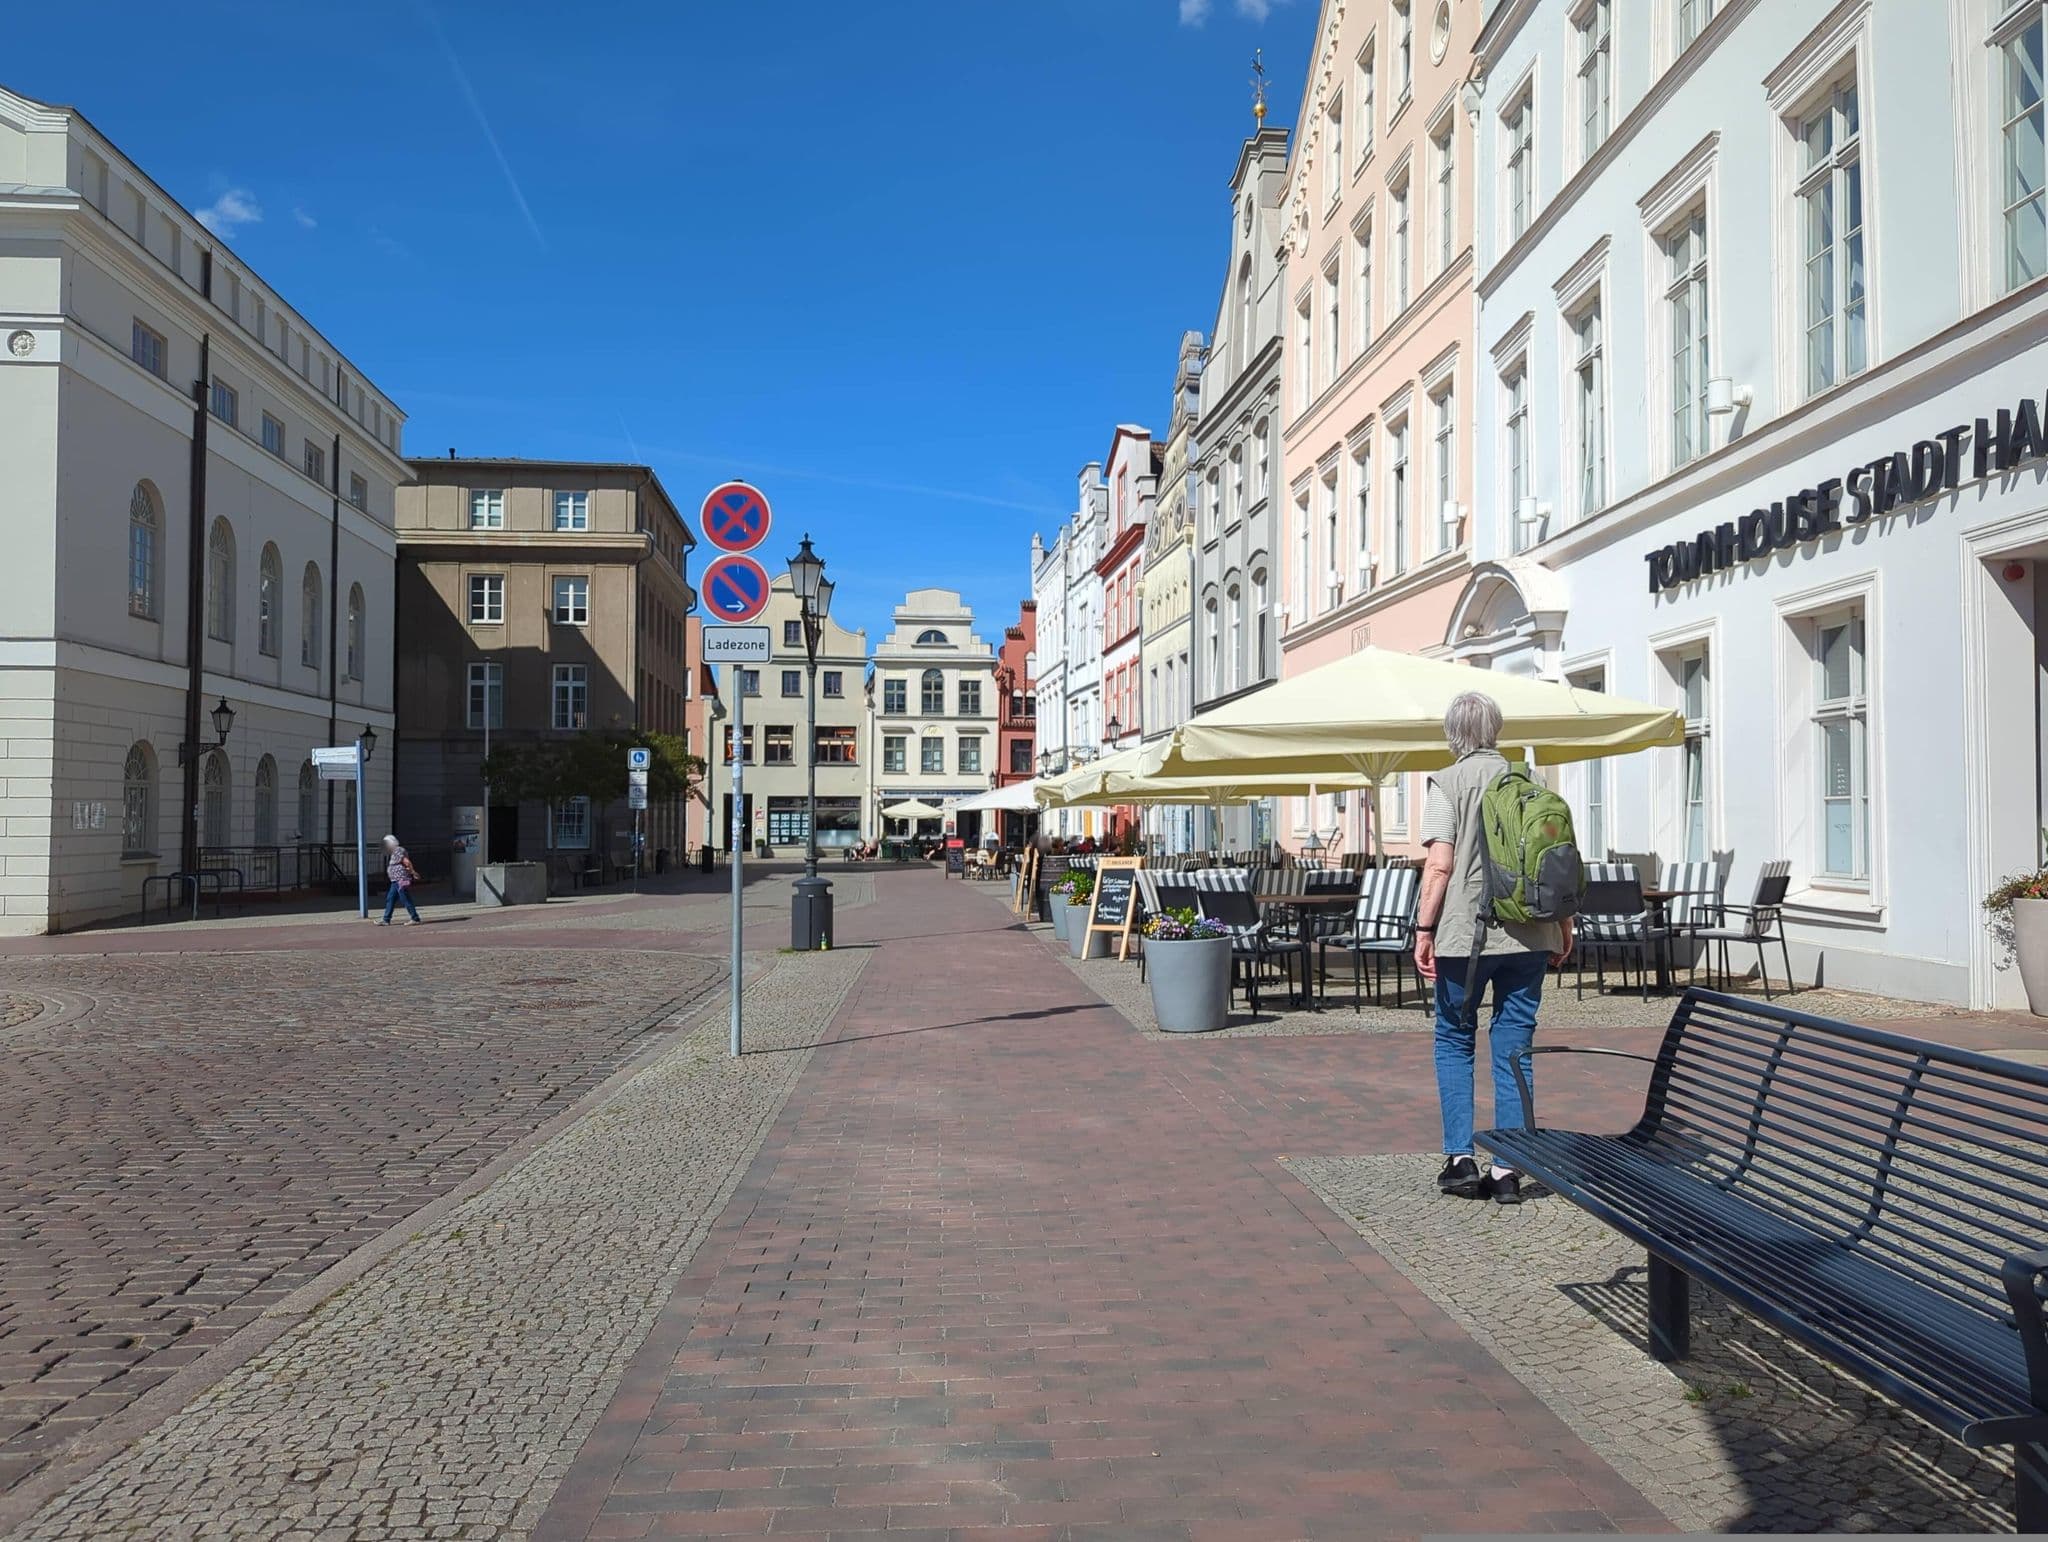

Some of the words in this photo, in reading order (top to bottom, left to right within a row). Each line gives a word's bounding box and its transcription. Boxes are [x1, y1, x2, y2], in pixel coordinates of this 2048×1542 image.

[1645, 478, 1842, 594] TOWNHOUSE
[1846, 425, 1971, 524] STADT
[1973, 388, 2048, 479] HA
[707, 638, 766, 651] Ladezone
